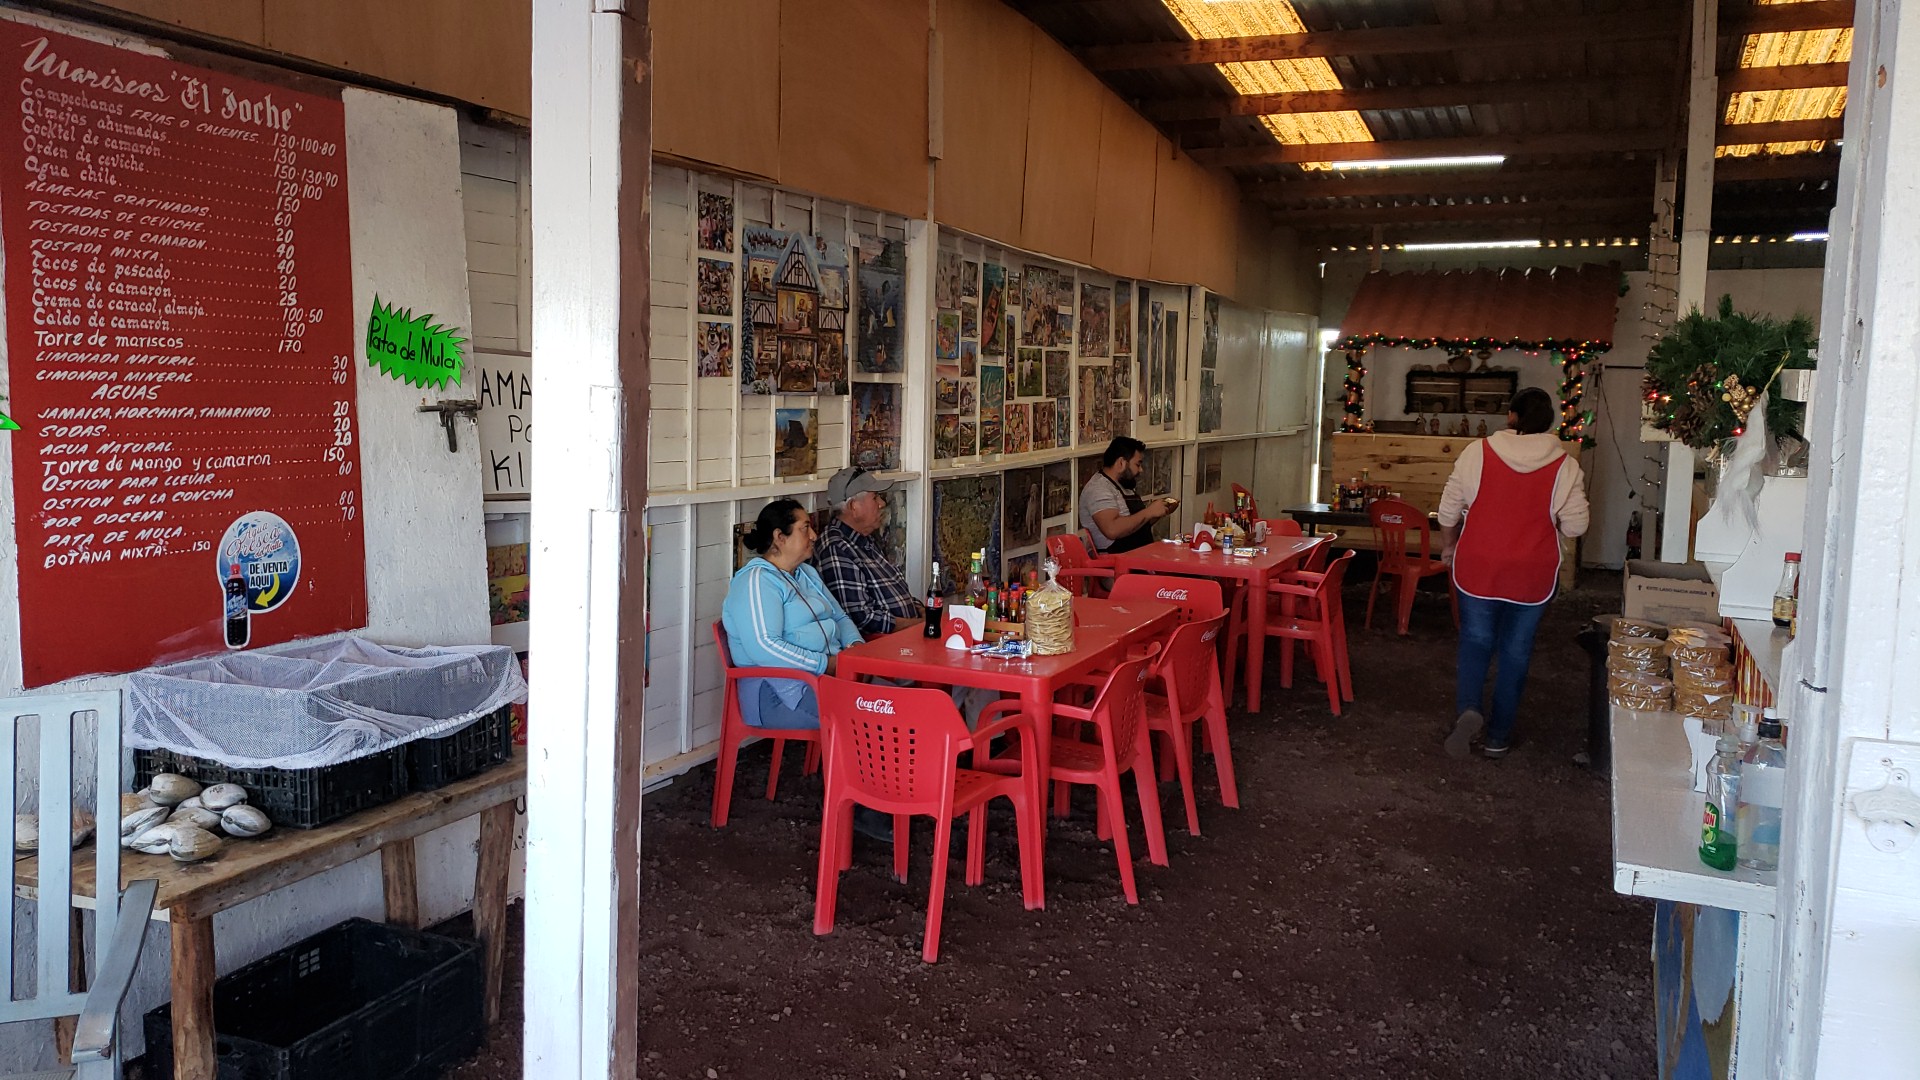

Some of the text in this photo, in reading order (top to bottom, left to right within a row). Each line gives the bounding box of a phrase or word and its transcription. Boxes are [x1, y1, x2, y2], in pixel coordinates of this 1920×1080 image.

[20, 36, 171, 102] Mariscos
[20, 77, 124, 116] Campechanas
[130, 109, 176, 126] FRIAS
[179, 119, 190, 129] O
[196, 122, 259, 142] CALIENTES
[82, 128, 99, 146] de
[97, 114, 167, 142] ahumadas
[273, 149, 297, 165] 130
[23, 134, 69, 160] Orden
[75, 145, 91, 163] de
[98, 153, 145, 173] ceviche
[25, 180, 292, 227] ALMEJAS GRATINADAS 60
[79, 164, 117, 186] chile
[276, 196, 300, 213] 150
[27, 200, 294, 243] TOSTADAS DE CEVICHE 20
[29, 218, 295, 259] TOSTADAS DE CAMARON 40
[29, 238, 295, 275] TOSTADA MIXTA 40
[32, 250, 297, 291] Tacos de pescado 20
[32, 268, 78, 292] Tacos
[84, 275, 102, 292] de
[31, 288, 82, 307] Crema
[86, 293, 104, 309] de
[164, 298, 205, 320] almeja
[33, 307, 81, 326] Caldo
[88, 310, 106, 328] de
[284, 321, 306, 338] 150
[34, 329, 301, 353] Torre de mariscos 170
[369, 315, 456, 370] Pata de Mula
[35, 350, 348, 370] LIMONADA NATURAL 30
[35, 369, 347, 385] LIMONADA MINERAL 40
[91, 383, 162, 400] AGUAS
[200, 406, 272, 419] TAMARINDO
[333, 400, 349, 417] 20
[38, 417, 351, 438] SODAS 20
[39, 443, 89, 456] AGUA
[96, 441, 173, 454] NATURAL
[41, 458, 99, 477] Torre
[105, 454, 123, 472] de
[192, 456, 202, 472] y
[206, 454, 271, 469] camaron
[323, 446, 345, 462] 150
[118, 476, 159, 489] PARA
[164, 472, 215, 486] LLEVAR
[338, 461, 353, 475] 60
[42, 488, 234, 511] OSTION EN LA CONCHA
[43, 490, 354, 529] POR DOCENA 80
[43, 506, 355, 548] PATA DE MULA 70
[43, 540, 211, 569] BOTANA MIXTA 150
[249, 561, 288, 575] DE VENTA
[250, 575, 270, 588] AQUI
[856, 696, 896, 715] Coca-Cola
